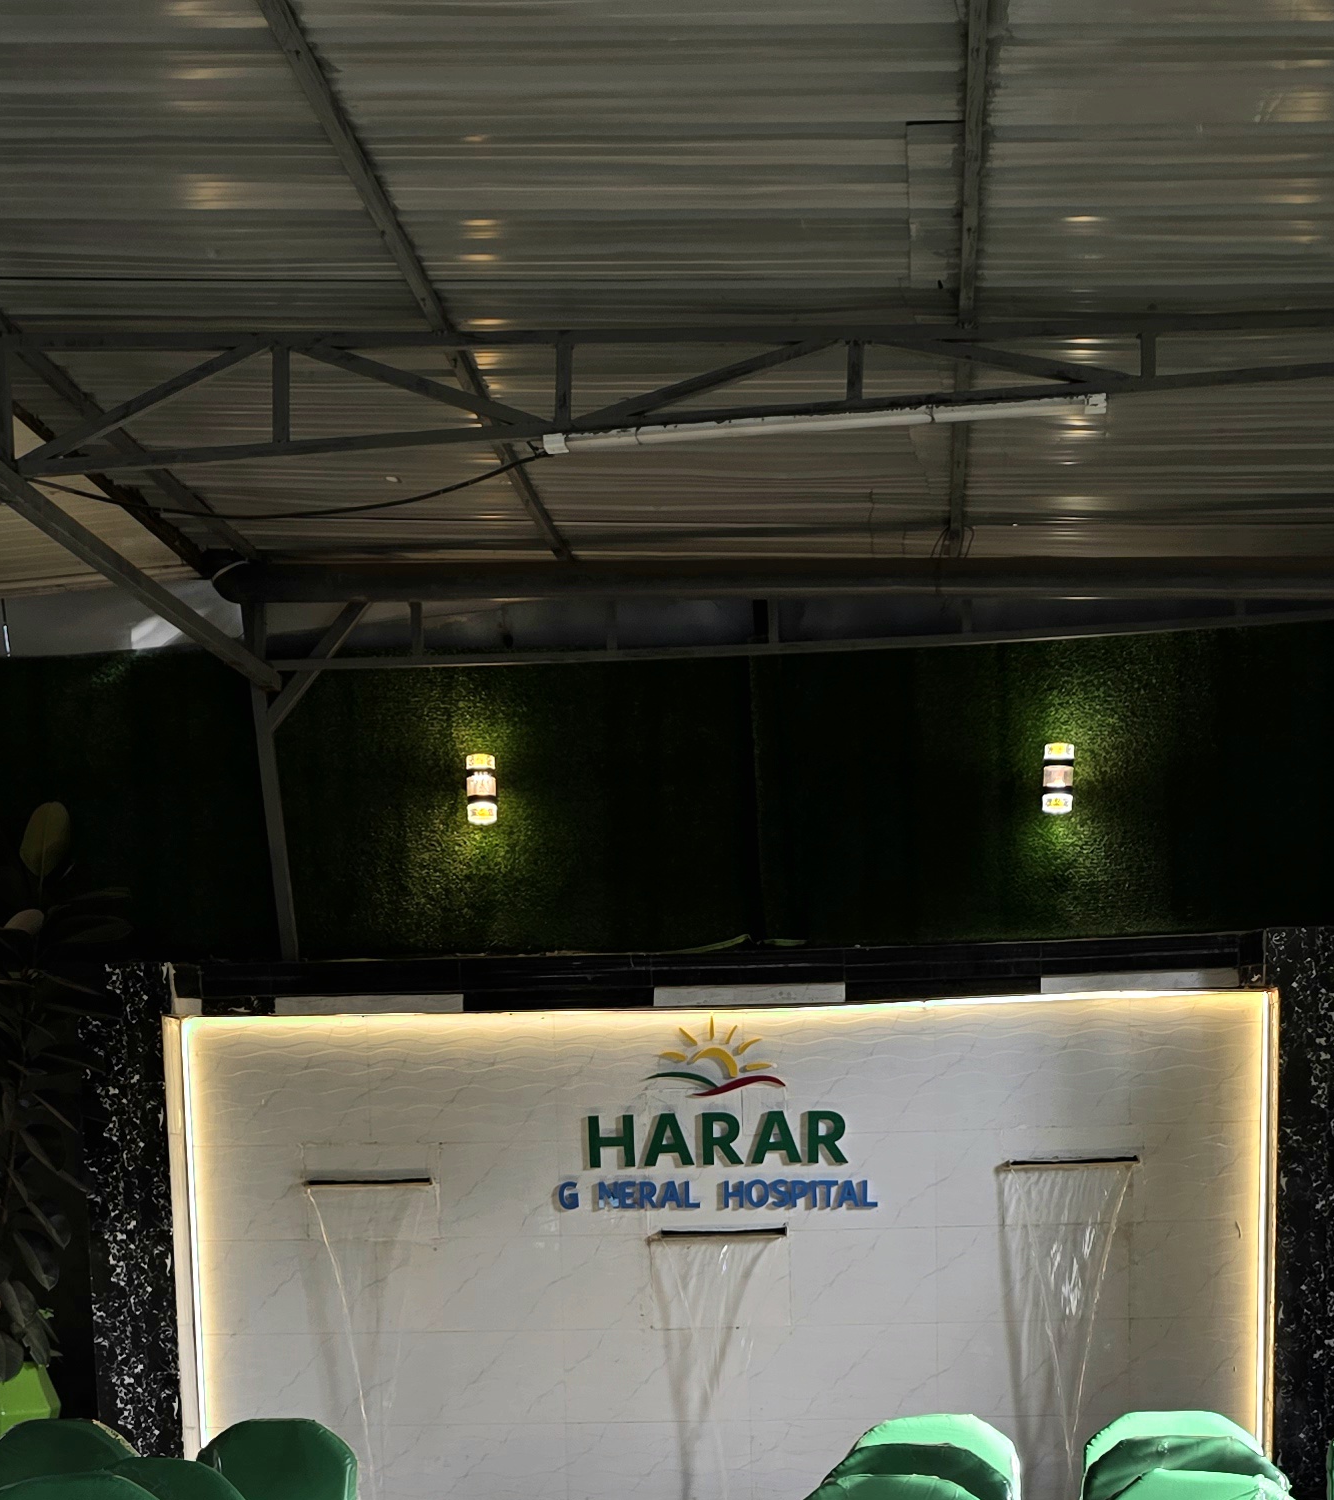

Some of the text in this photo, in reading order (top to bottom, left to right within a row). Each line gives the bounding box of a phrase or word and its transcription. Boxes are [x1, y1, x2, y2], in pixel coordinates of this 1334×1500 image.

[588, 1110, 848, 1168] HARAR
[558, 1178, 878, 1210] GNERAL HOSPITAL
